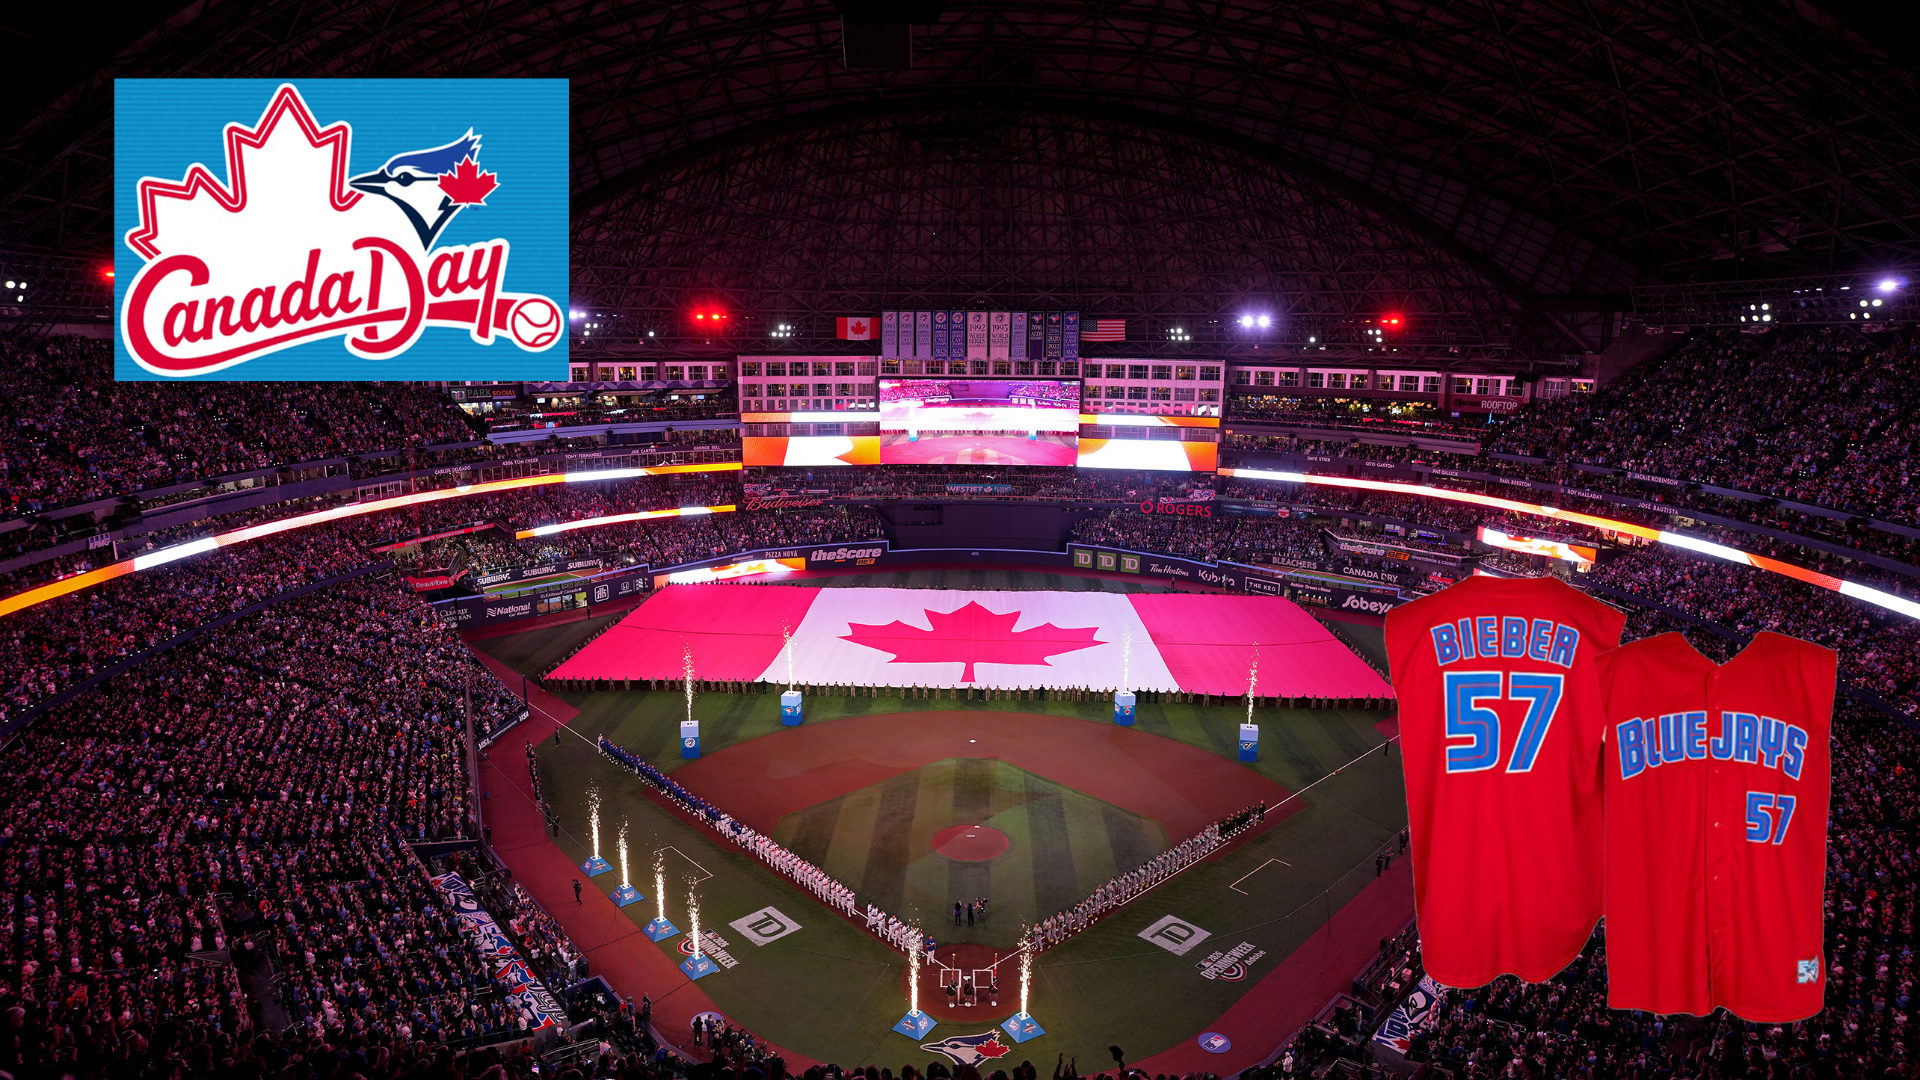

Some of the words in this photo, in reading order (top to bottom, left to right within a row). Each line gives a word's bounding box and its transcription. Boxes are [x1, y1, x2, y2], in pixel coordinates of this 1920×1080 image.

[468, 389, 490, 397] PARK
[1481, 400, 1518, 410] ROOFTOP
[1511, 480, 1532, 488] BEESTON
[1634, 473, 1650, 481] JACKIE
[1651, 476, 1679, 485] ROBINSON
[1577, 491, 1603, 500] HALLADAY
[743, 496, 824, 511] Budweiser
[1157, 502, 1212, 517] ROGERS
[1653, 505, 1679, 515] BAUTISTA
[811, 547, 882, 561] theScore
[1340, 542, 1385, 556] theScore
[1388, 551, 1409, 560] BET
[567, 559, 600, 570] SUBWAY
[1076, 553, 1091, 565] TD
[1100, 555, 1114, 567] TD
[1123, 558, 1138, 570] TD
[1272, 556, 1318, 570] BLEACHERS
[523, 565, 556, 577] SUBWAY
[1150, 564, 1163, 573] Tim
[1163, 565, 1189, 577] Hortons
[1198, 569, 1235, 586] Kubta
[1343, 566, 1379, 579] CANADA
[1381, 572, 1398, 582] DRY
[477, 573, 510, 585] SUBWAY
[1263, 584, 1276, 592] KEG
[496, 602, 531, 616] National
[1342, 595, 1393, 615] Sobeys
[1430, 615, 1580, 669] BIEBER
[1443, 670, 1564, 774] 57
[478, 737, 491, 751] VISA
[1616, 710, 1708, 780] BLUE
[1709, 711, 1808, 781] JAYS
[1745, 790, 1797, 846] 57
[747, 911, 787, 937] TD
[1149, 922, 1195, 946] TD
[712, 950, 740, 969] WEEK
[1200, 955, 1239, 980] OPENING
[1228, 941, 1256, 959] WEEK
